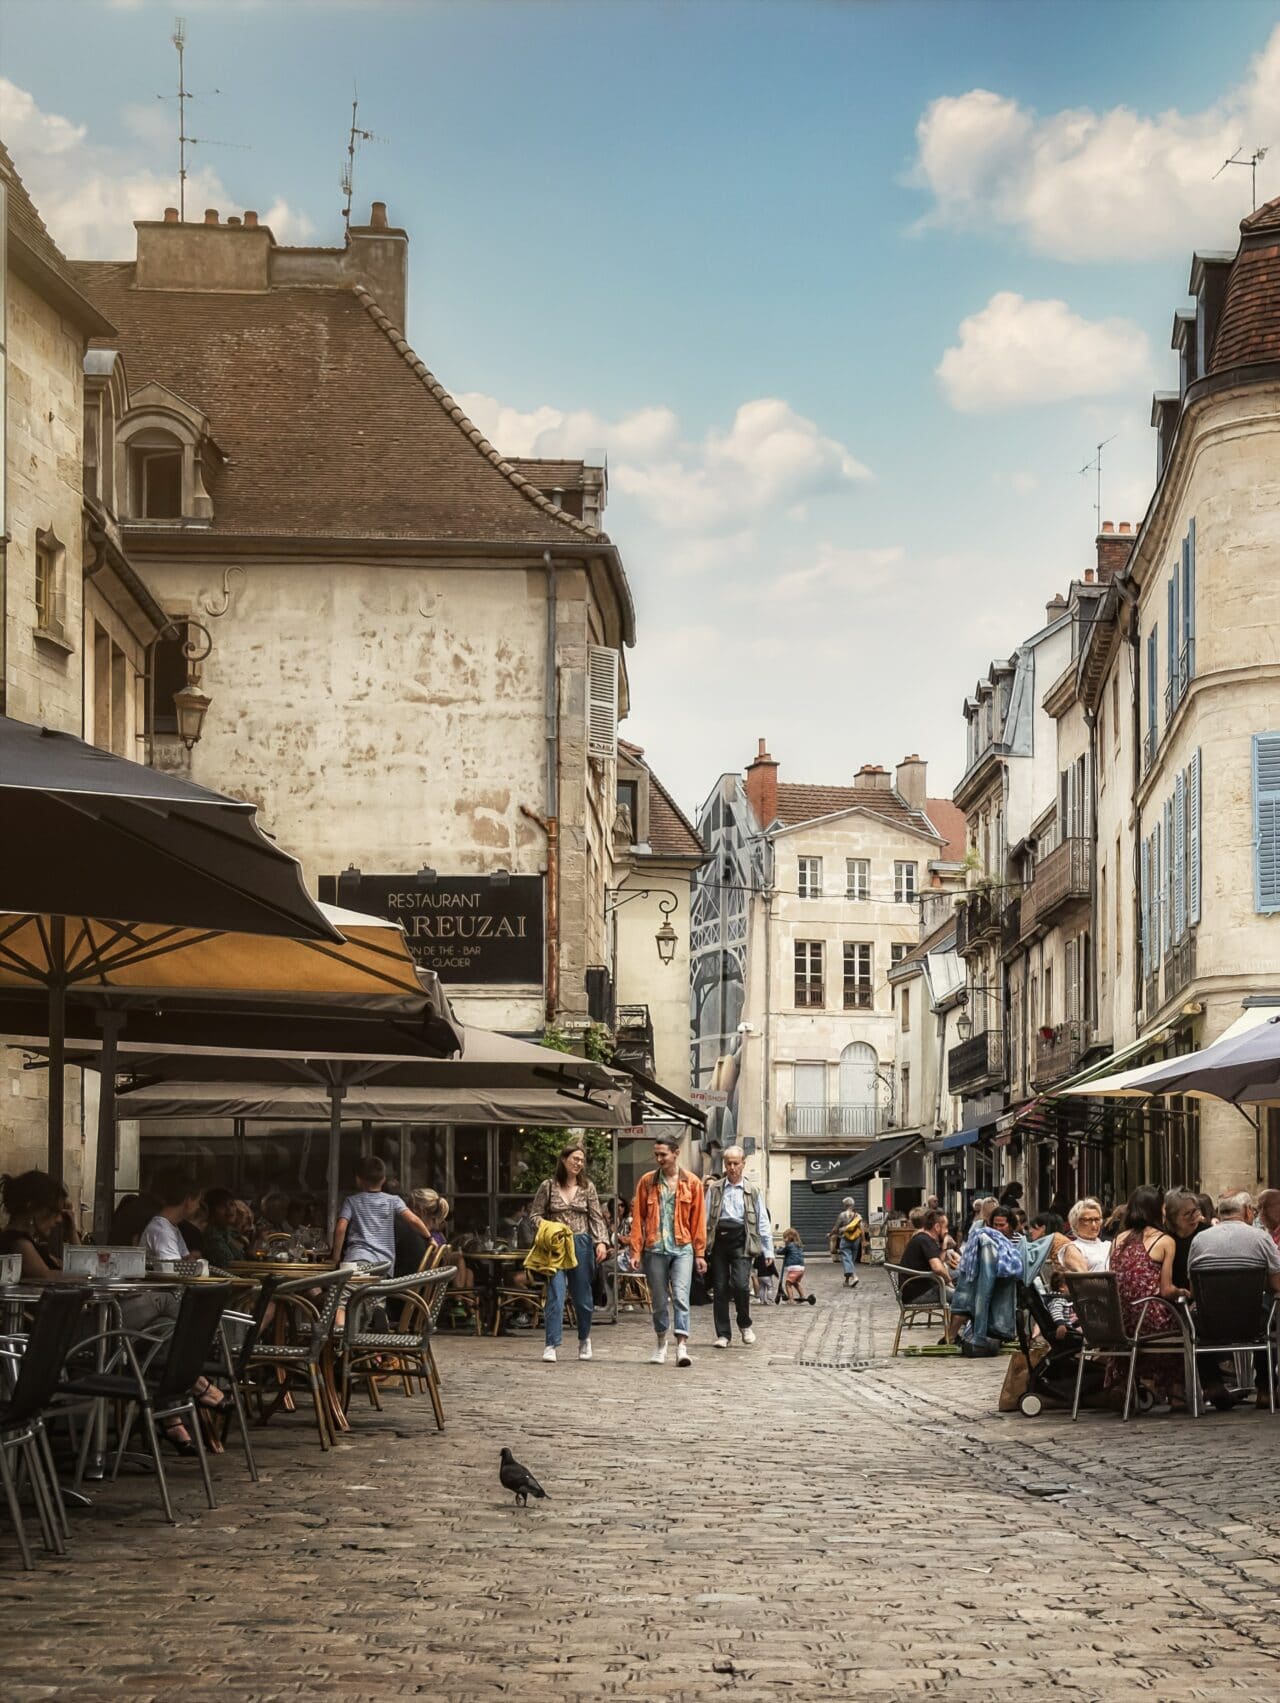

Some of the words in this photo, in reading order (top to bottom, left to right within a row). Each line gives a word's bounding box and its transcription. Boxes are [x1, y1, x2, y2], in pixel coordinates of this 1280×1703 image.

[388, 893, 481, 908] RESTAURANT
[378, 915, 527, 938] AREUZAI
[423, 945, 436, 955] DE
[463, 945, 481, 955] BAR
[432, 957, 471, 967] GLACIER
